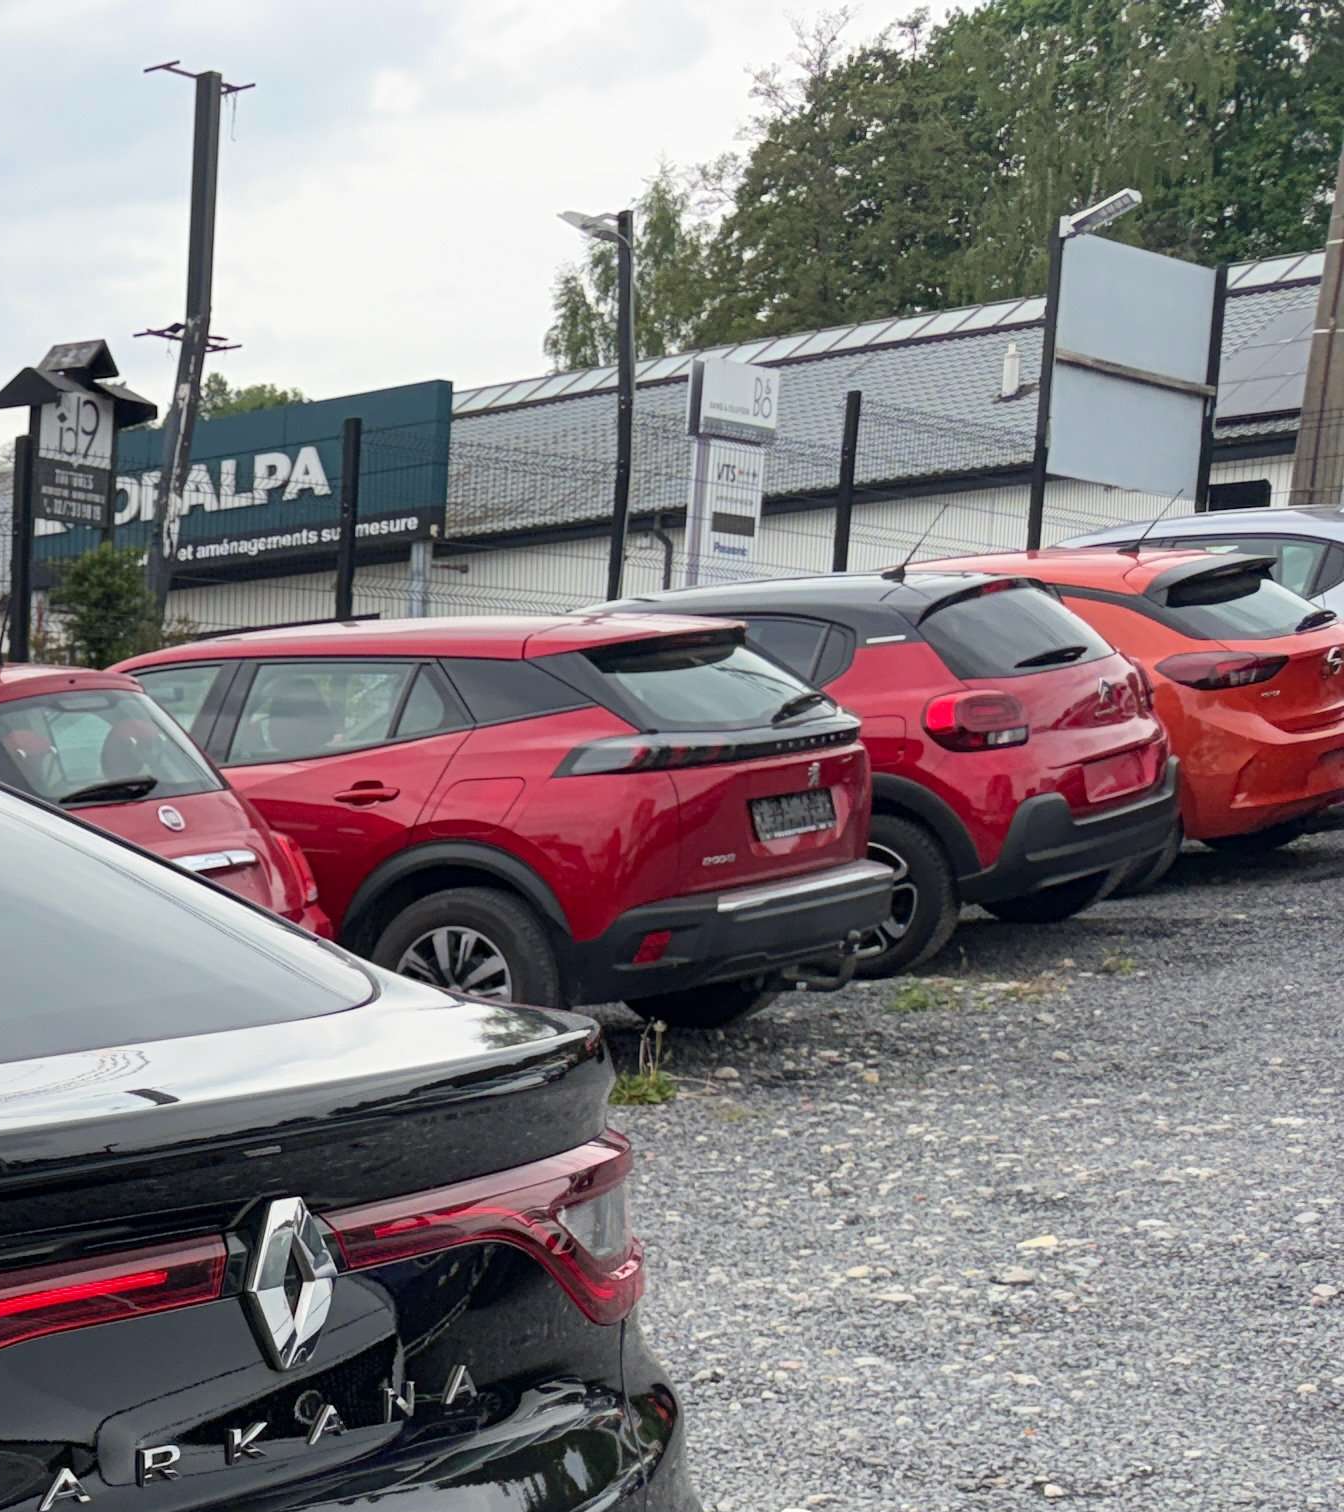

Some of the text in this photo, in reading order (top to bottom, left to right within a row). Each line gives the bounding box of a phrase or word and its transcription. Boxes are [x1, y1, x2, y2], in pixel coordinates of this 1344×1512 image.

[34, 446, 332, 536] OALPA
[178, 544, 195, 562] et
[196, 530, 318, 559] aménagements
[355, 517, 419, 538] mesure
[36, 1363, 480, 1512] ARKANA
